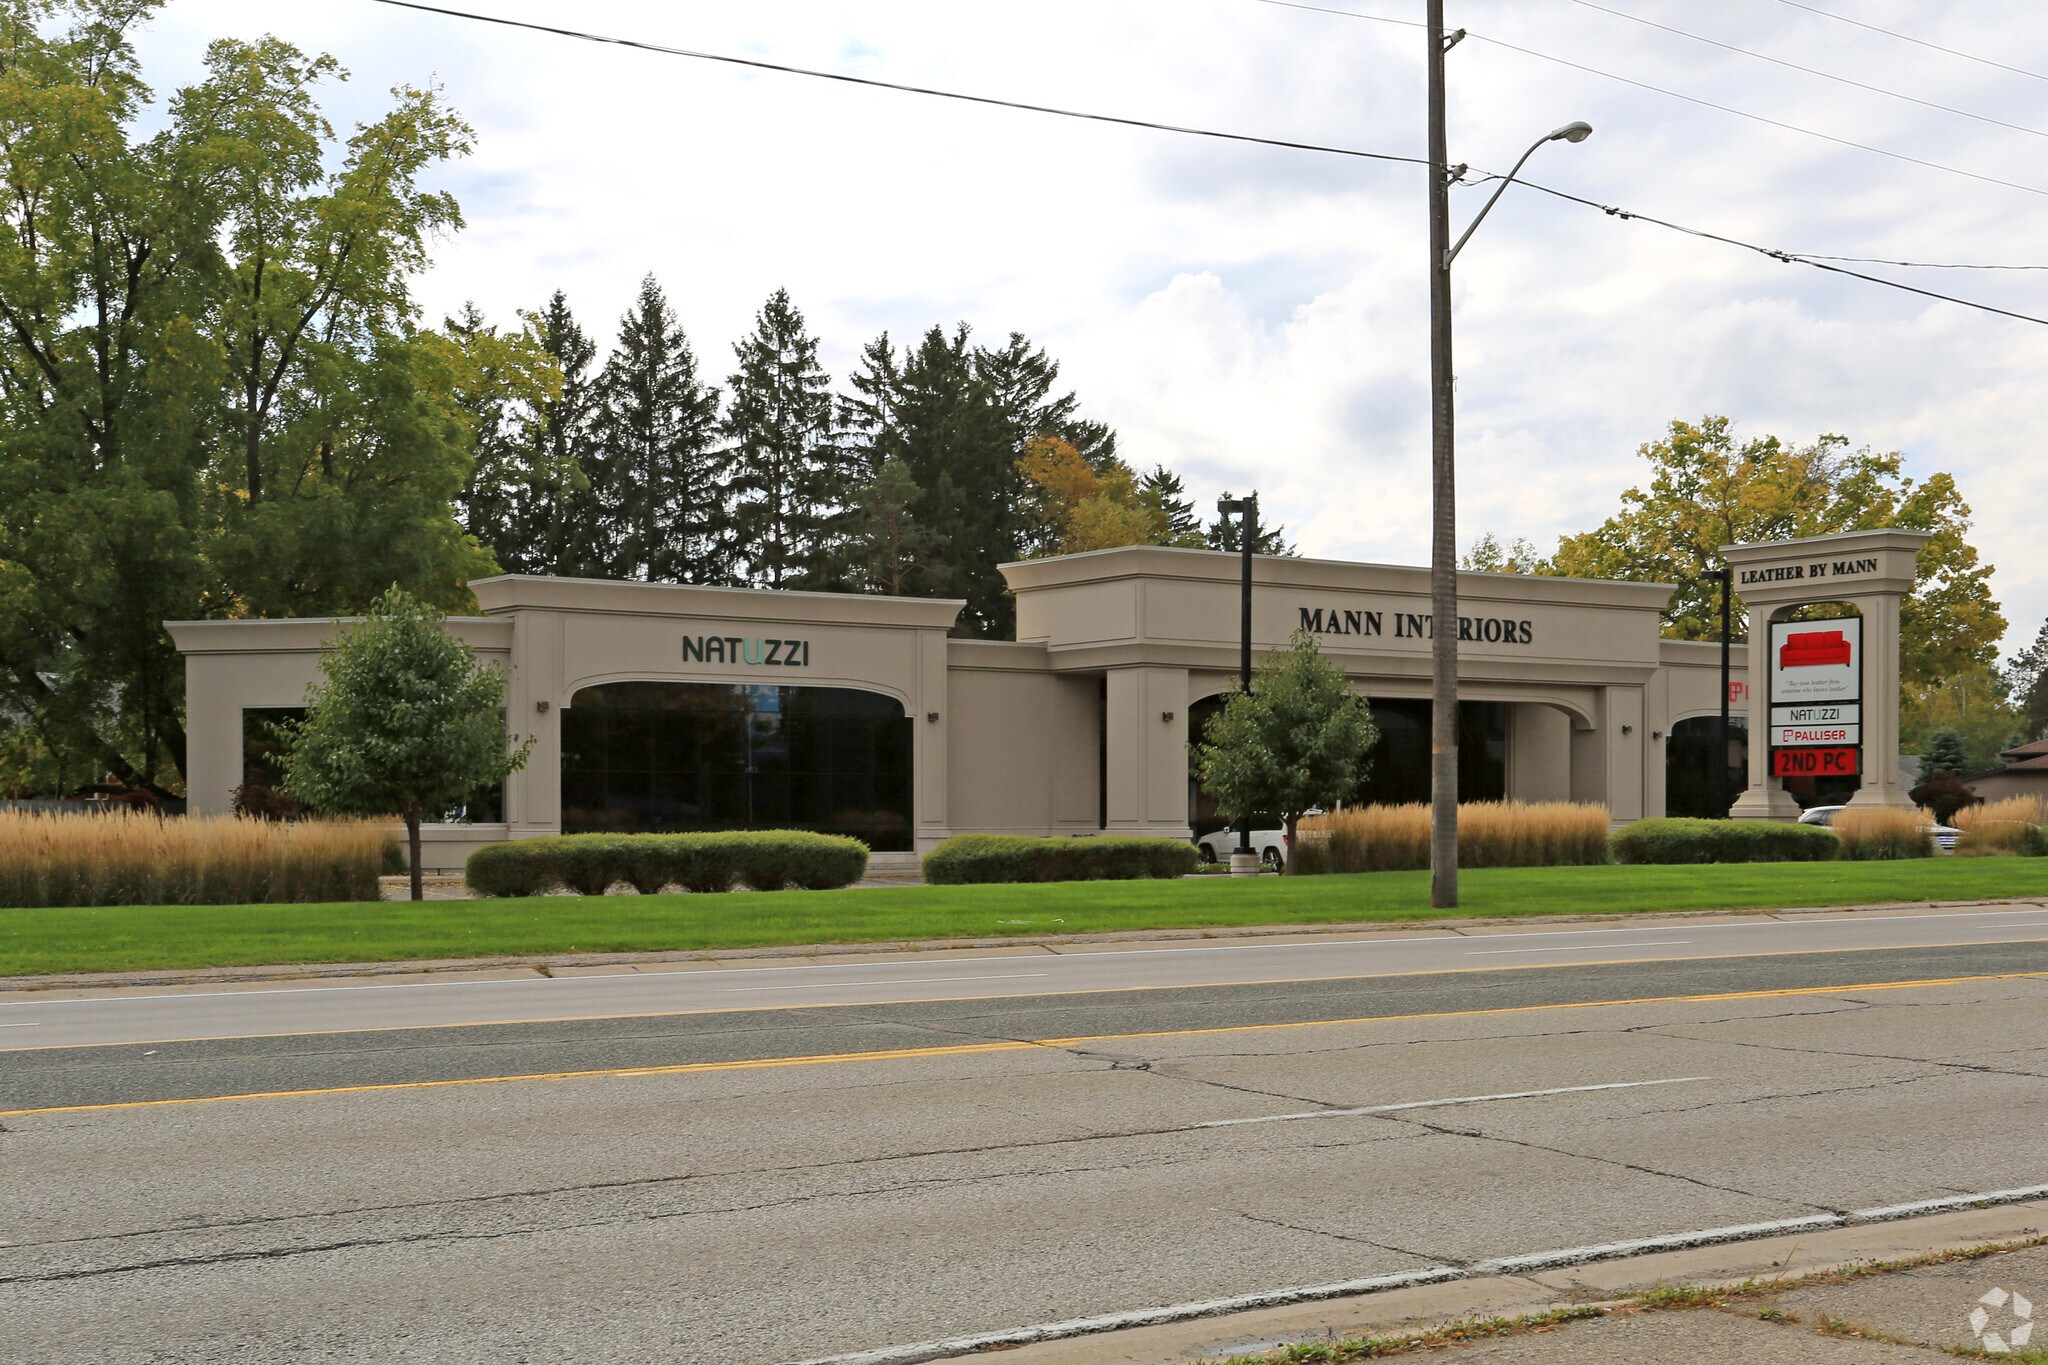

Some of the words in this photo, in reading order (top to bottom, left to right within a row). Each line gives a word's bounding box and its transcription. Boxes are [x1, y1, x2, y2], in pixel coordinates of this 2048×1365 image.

[1741, 566, 1804, 584] LEATHER
[1809, 563, 1827, 577] BY
[1832, 558, 1878, 576] MANN
[1299, 607, 1383, 636] MANN
[1394, 613, 1533, 644] INTRIORS
[682, 635, 809, 666] NATUZZI
[1790, 708, 1840, 721] NATUZZI
[1795, 730, 1846, 741] PALLISER
[1781, 752, 1817, 772] 2ND
[1823, 751, 1847, 771] PC
